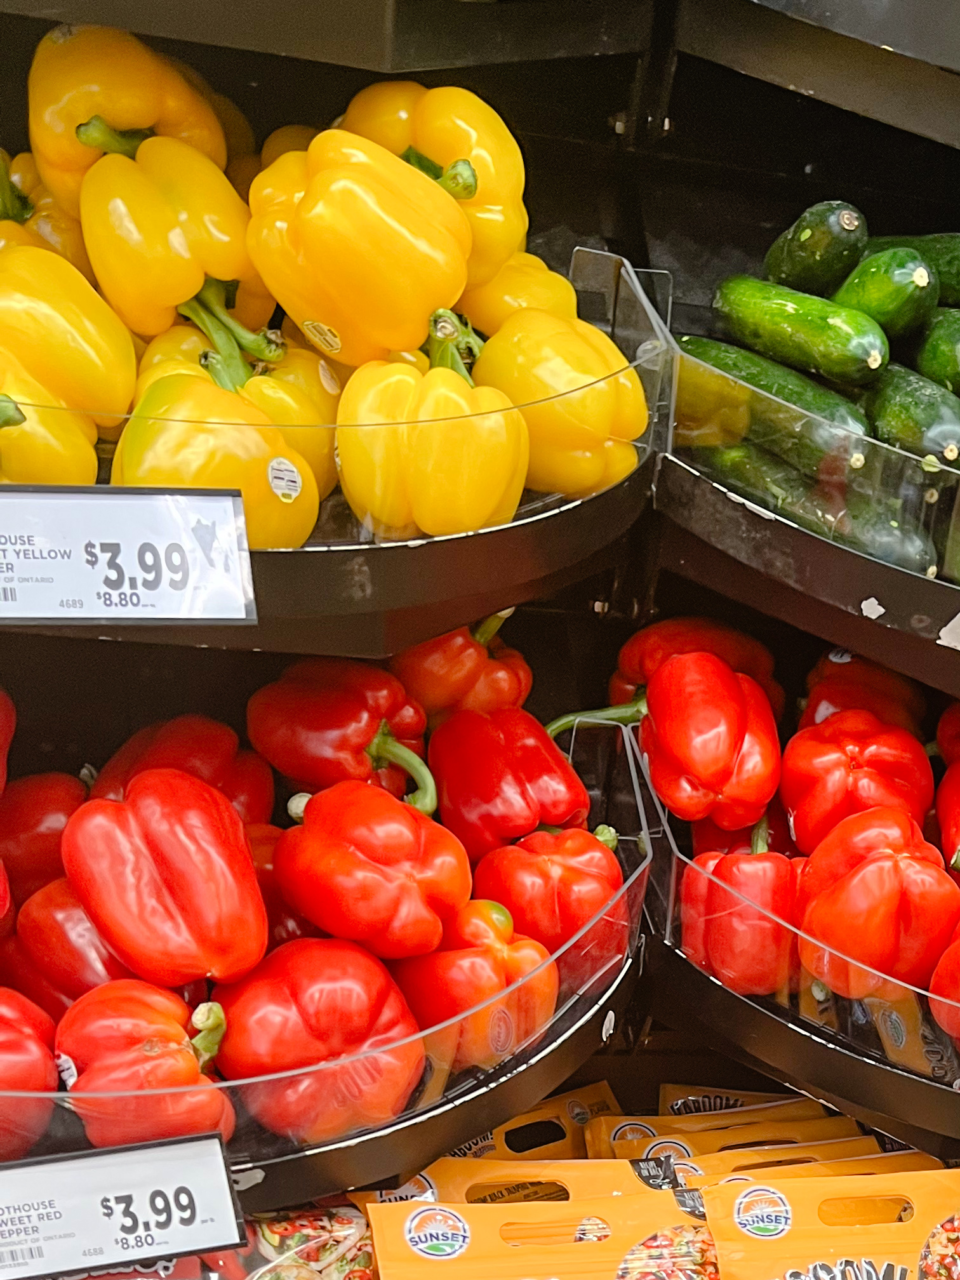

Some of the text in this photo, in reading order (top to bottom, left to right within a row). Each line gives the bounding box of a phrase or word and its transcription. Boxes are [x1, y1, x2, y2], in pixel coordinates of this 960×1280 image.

[13, 549, 72, 560] YELLOW
[84, 540, 190, 592] $3.99
[58, 599, 84, 609] 4689
[96, 591, 141, 608] $8.80
[37, 1210, 63, 1222] RED
[100, 1186, 197, 1236] $3.99
[738, 1215, 791, 1230] SUNSET
[114, 1233, 155, 1250] $8.80
[409, 1231, 470, 1247] SUNSET
